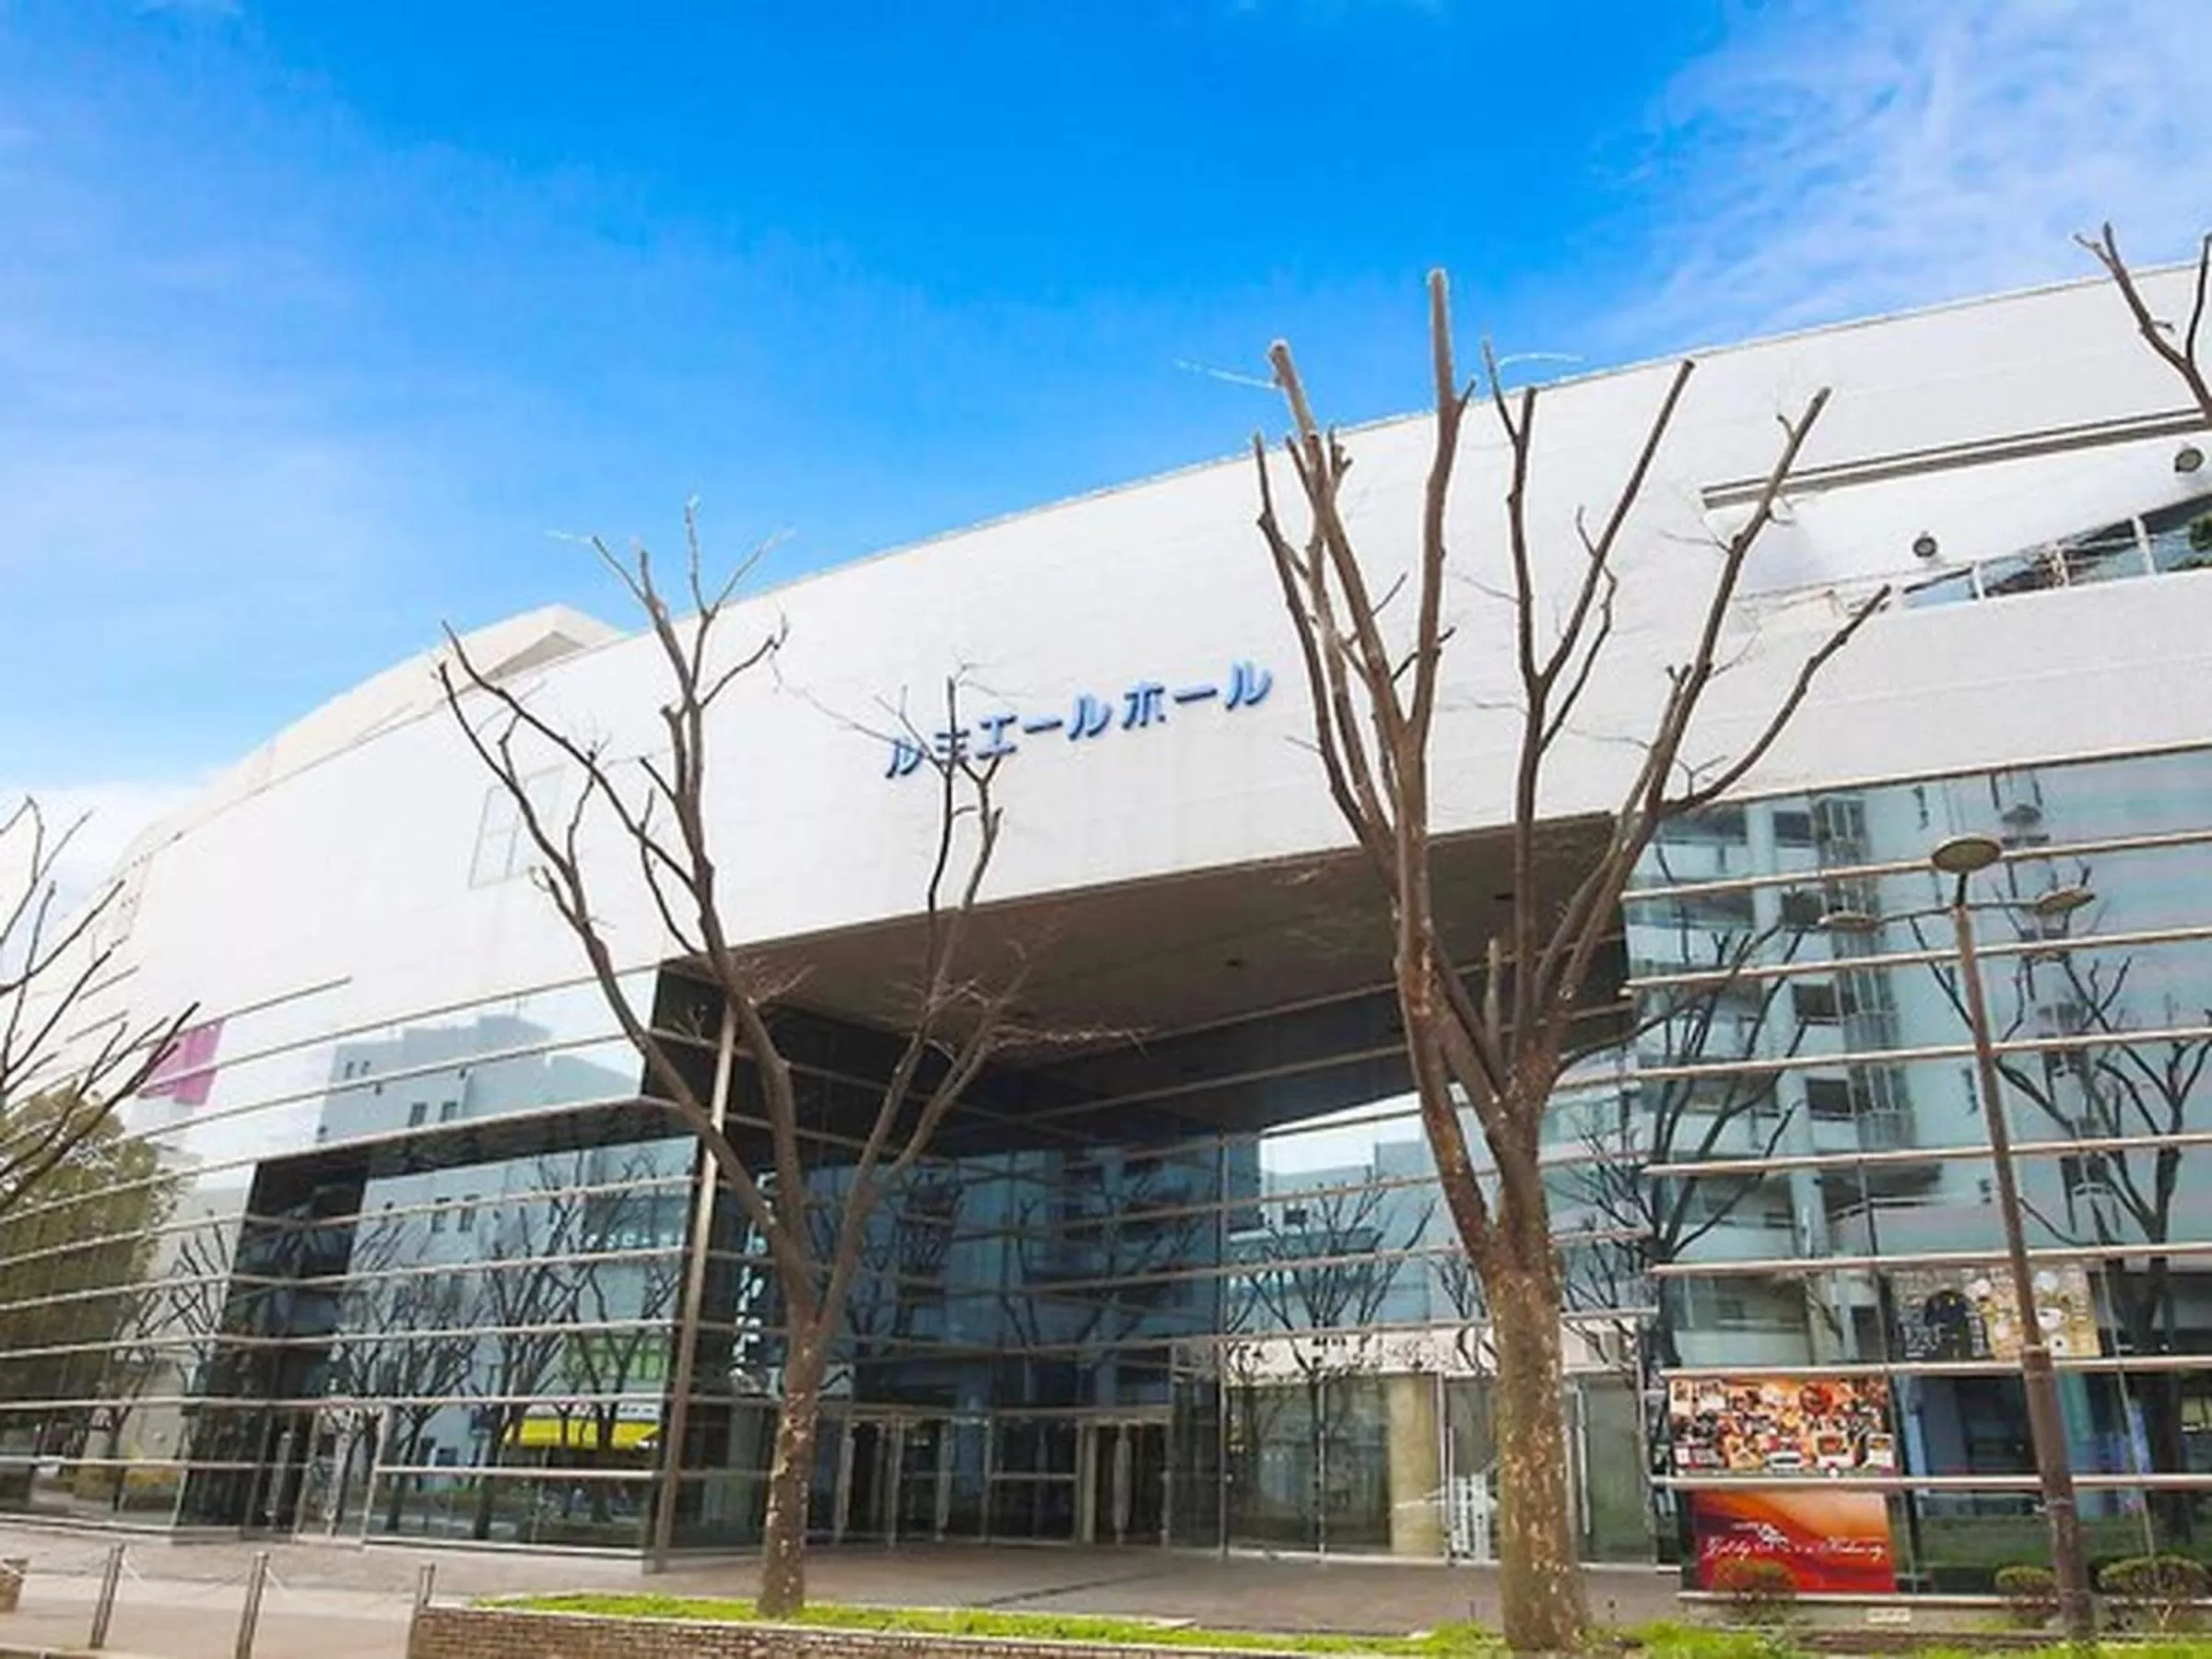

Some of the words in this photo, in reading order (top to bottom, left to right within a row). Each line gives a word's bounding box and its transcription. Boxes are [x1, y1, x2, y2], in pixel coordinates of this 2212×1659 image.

[886, 661, 1273, 778] ルミエールホール
